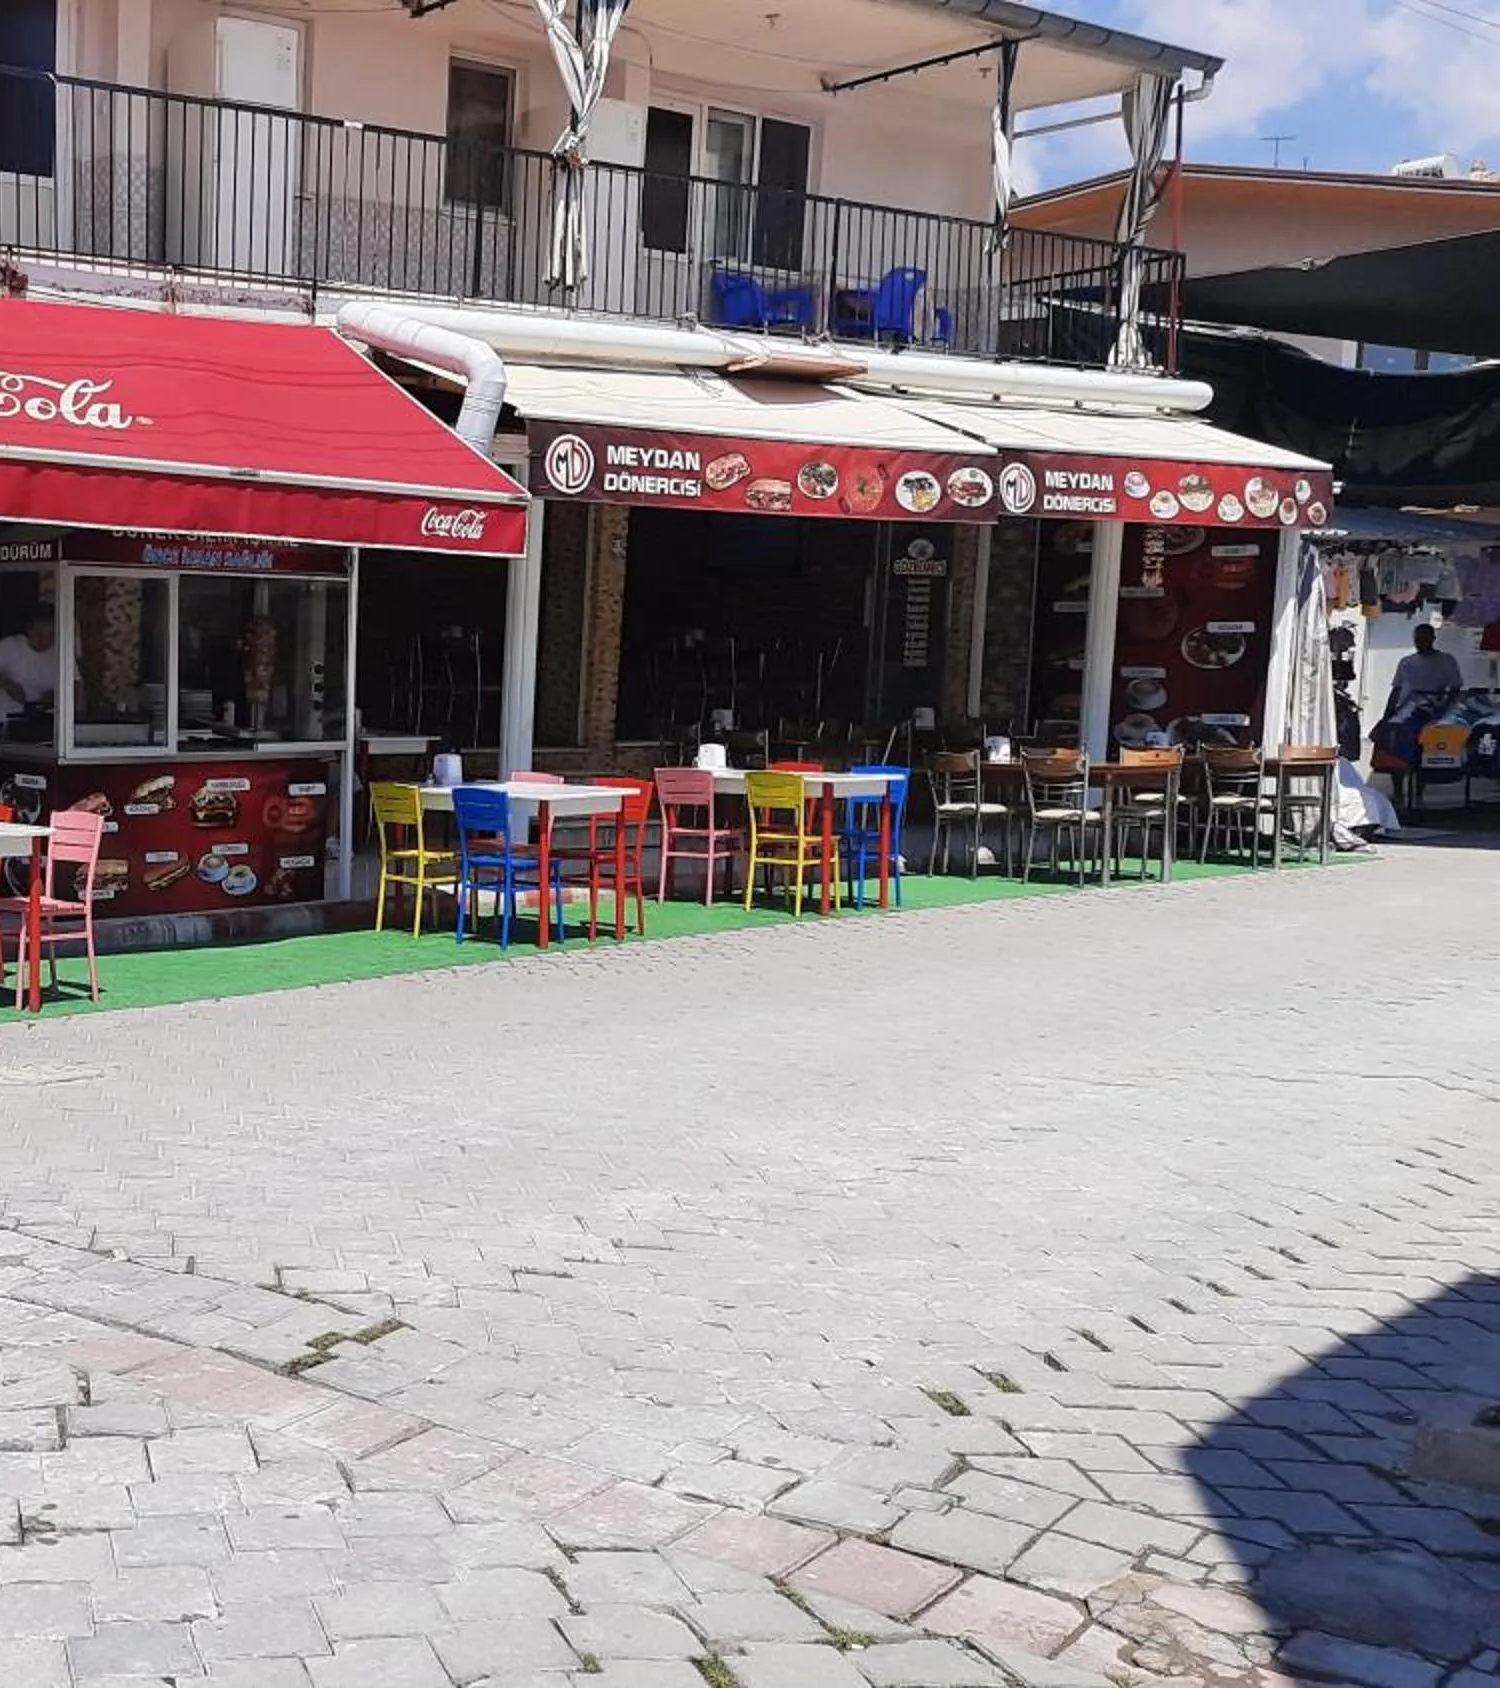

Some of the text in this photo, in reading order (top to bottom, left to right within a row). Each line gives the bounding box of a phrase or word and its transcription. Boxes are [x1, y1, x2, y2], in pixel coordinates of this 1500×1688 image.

[607, 445, 701, 471] MEYDAN
[604, 471, 701, 497] DÖNERCİSİ
[1045, 471, 1115, 491] MEYDAN
[1043, 493, 1117, 513] DÖNERCİSİ
[421, 506, 488, 539] Coca-Cola
[0, 542, 52, 561] DÜRÜM
